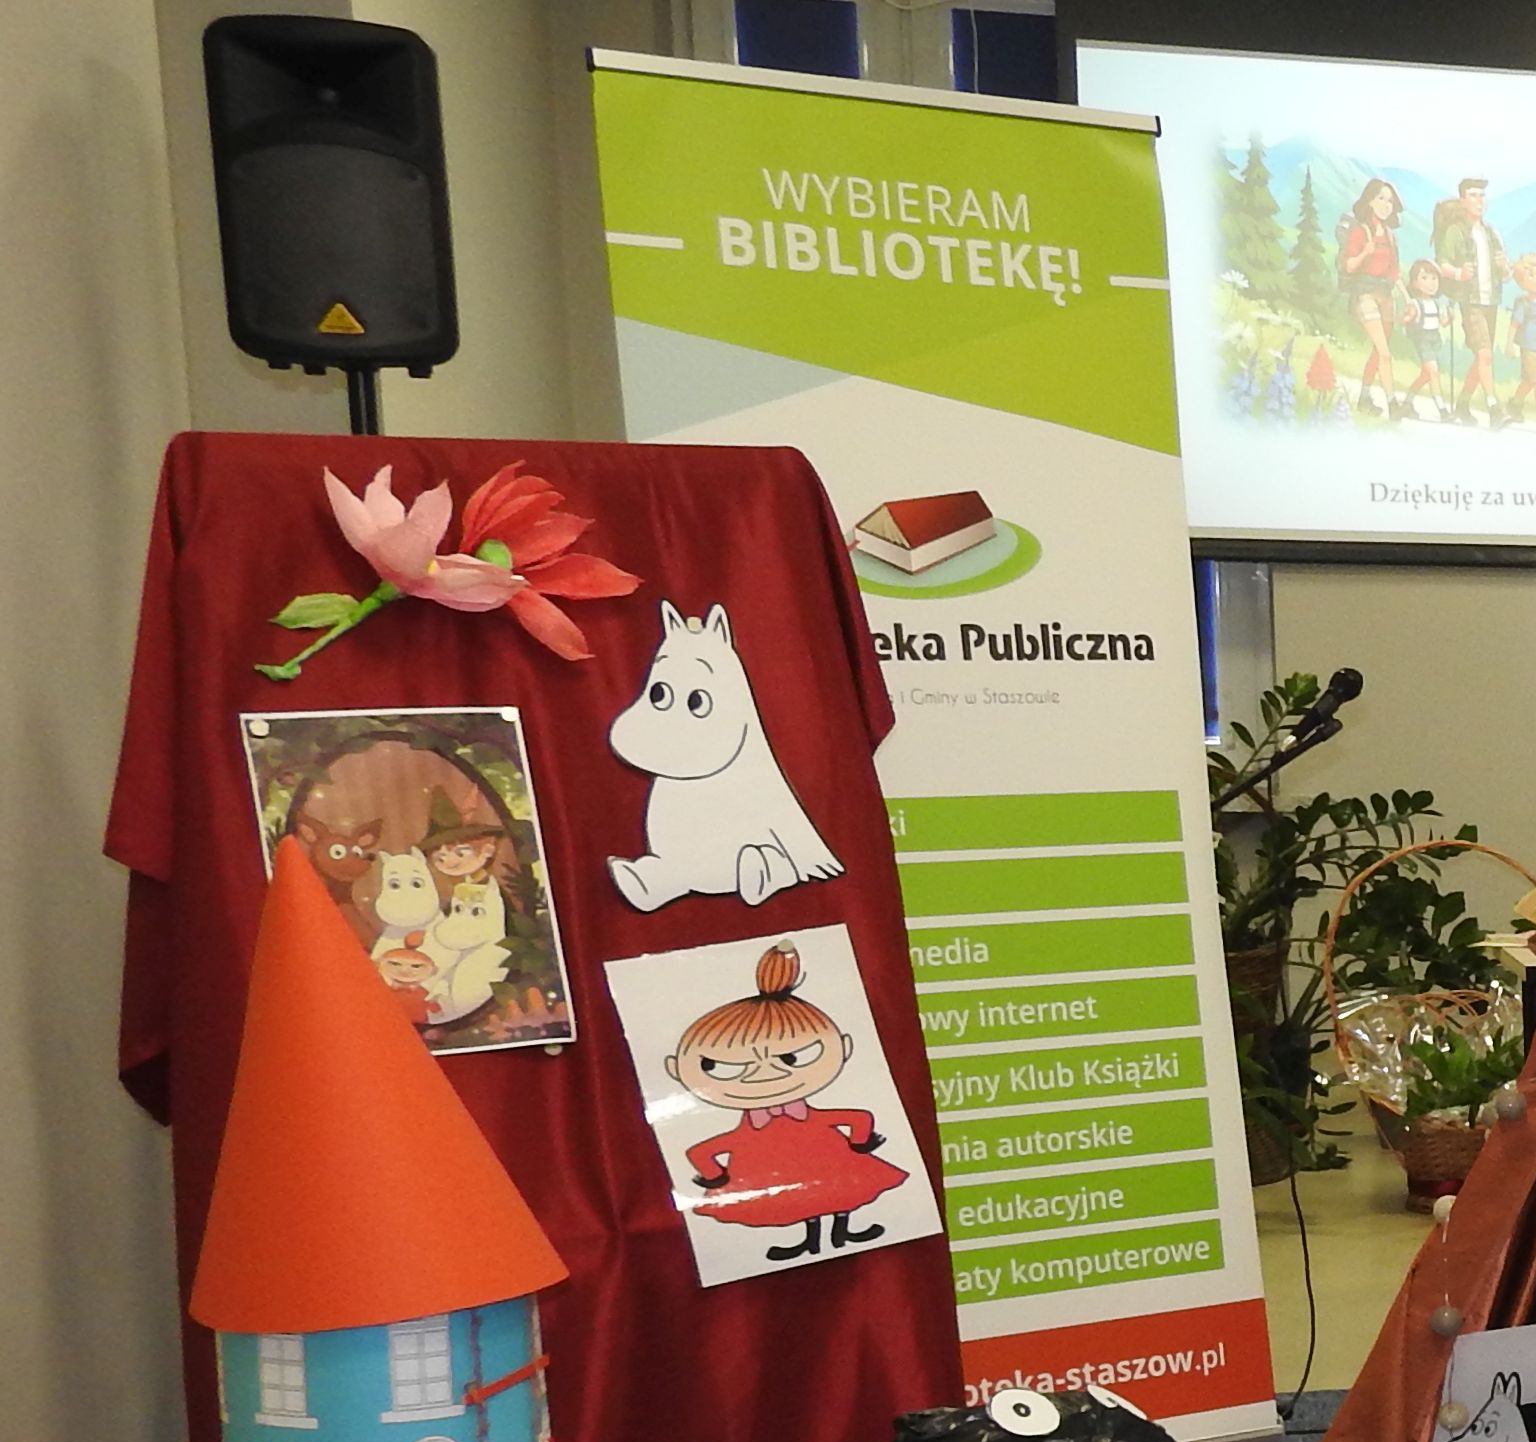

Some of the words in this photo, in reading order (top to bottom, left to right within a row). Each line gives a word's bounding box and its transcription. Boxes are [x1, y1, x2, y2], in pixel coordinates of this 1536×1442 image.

[761, 167, 1031, 233] WYBIERAM
[717, 215, 1083, 306] BIBLIOTEKĘ!
[1370, 482, 1474, 511] Dziękuję
[1480, 491, 1504, 505] za
[960, 621, 1155, 661] Publiczna
[910, 688, 958, 707] Gminy
[983, 687, 1061, 705] Staszowie
[979, 996, 1098, 1027] internet
[1009, 1062, 1074, 1092] Klub
[1084, 1052, 1180, 1088] Książki
[997, 1121, 1134, 1158] autorskie
[958, 1187, 1125, 1227] edukacyjne
[1010, 1240, 1210, 1284] komputerowe
